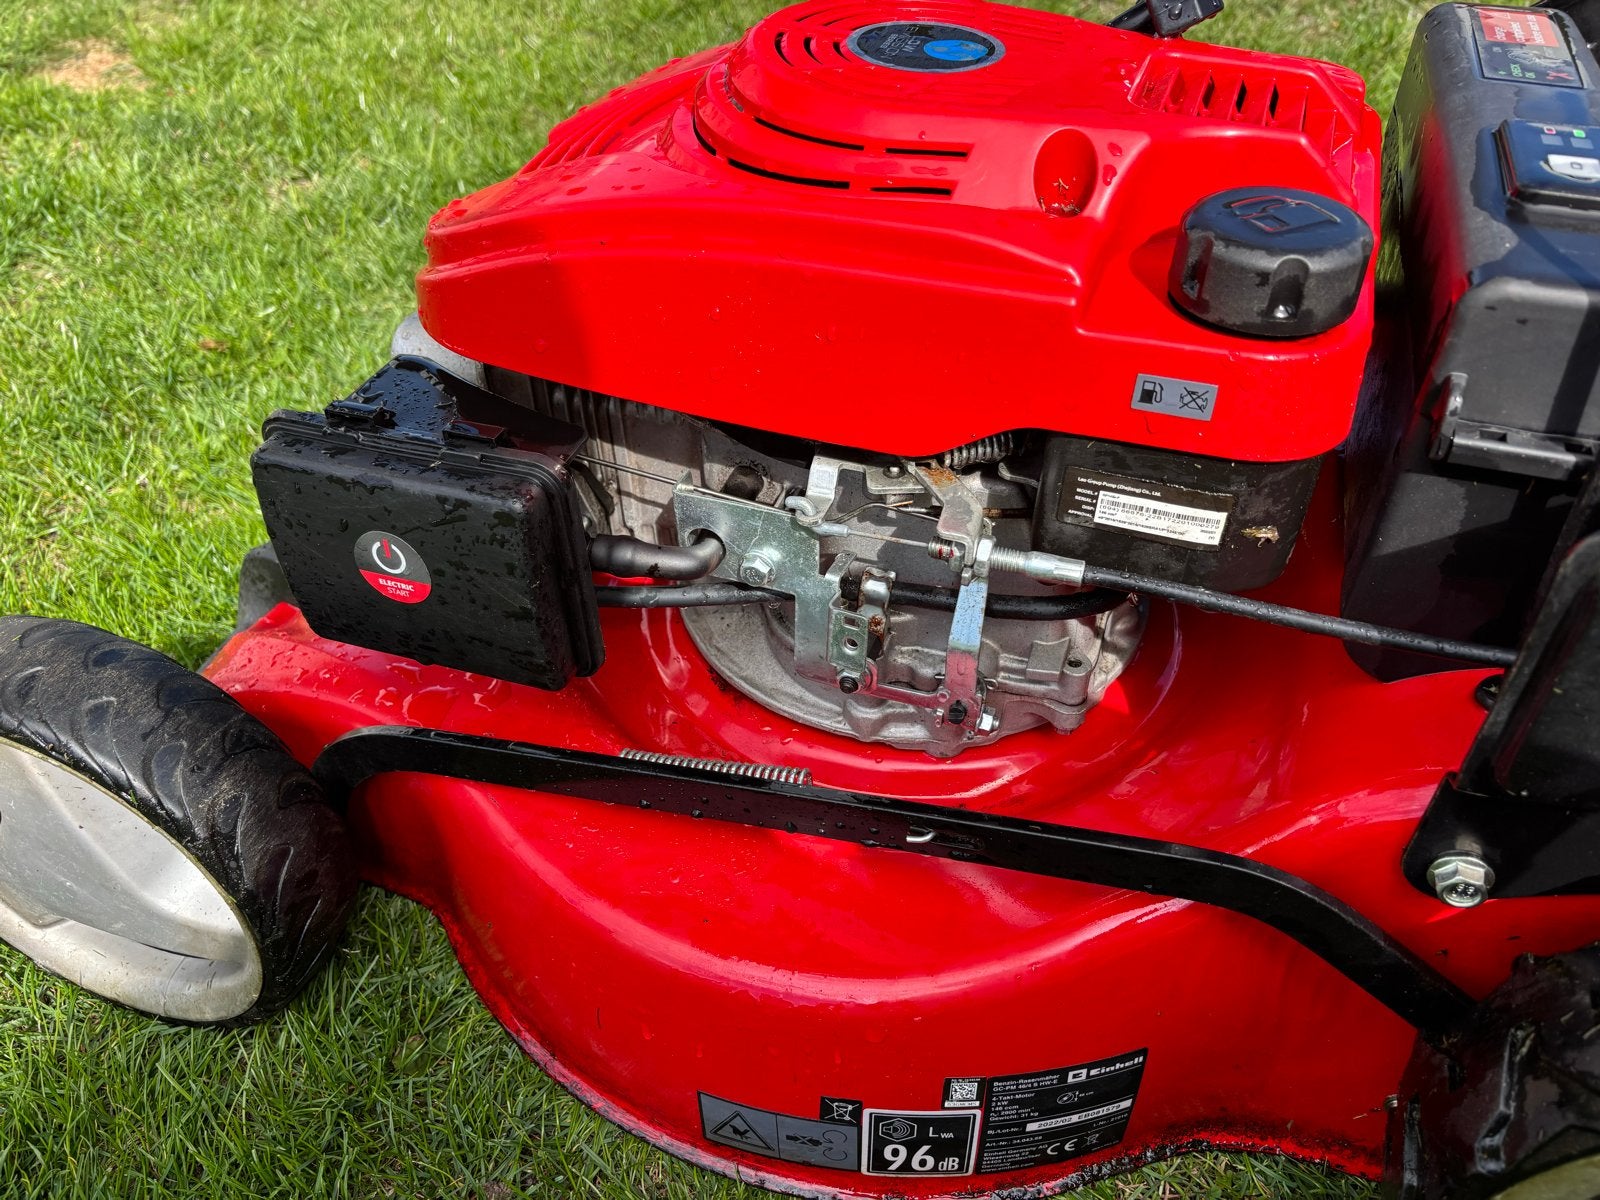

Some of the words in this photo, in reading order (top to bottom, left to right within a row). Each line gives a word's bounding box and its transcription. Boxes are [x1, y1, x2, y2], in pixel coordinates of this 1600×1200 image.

[379, 578, 415, 592] ELECTRIC
[387, 587, 410, 597] START
[1089, 1055, 1144, 1076] Einhell
[991, 1093, 1036, 1101] 4-Takt-Motor
[1037, 1117, 1072, 1128] 2022/02
[883, 1144, 935, 1171] 96
[938, 1157, 959, 1171] dB
